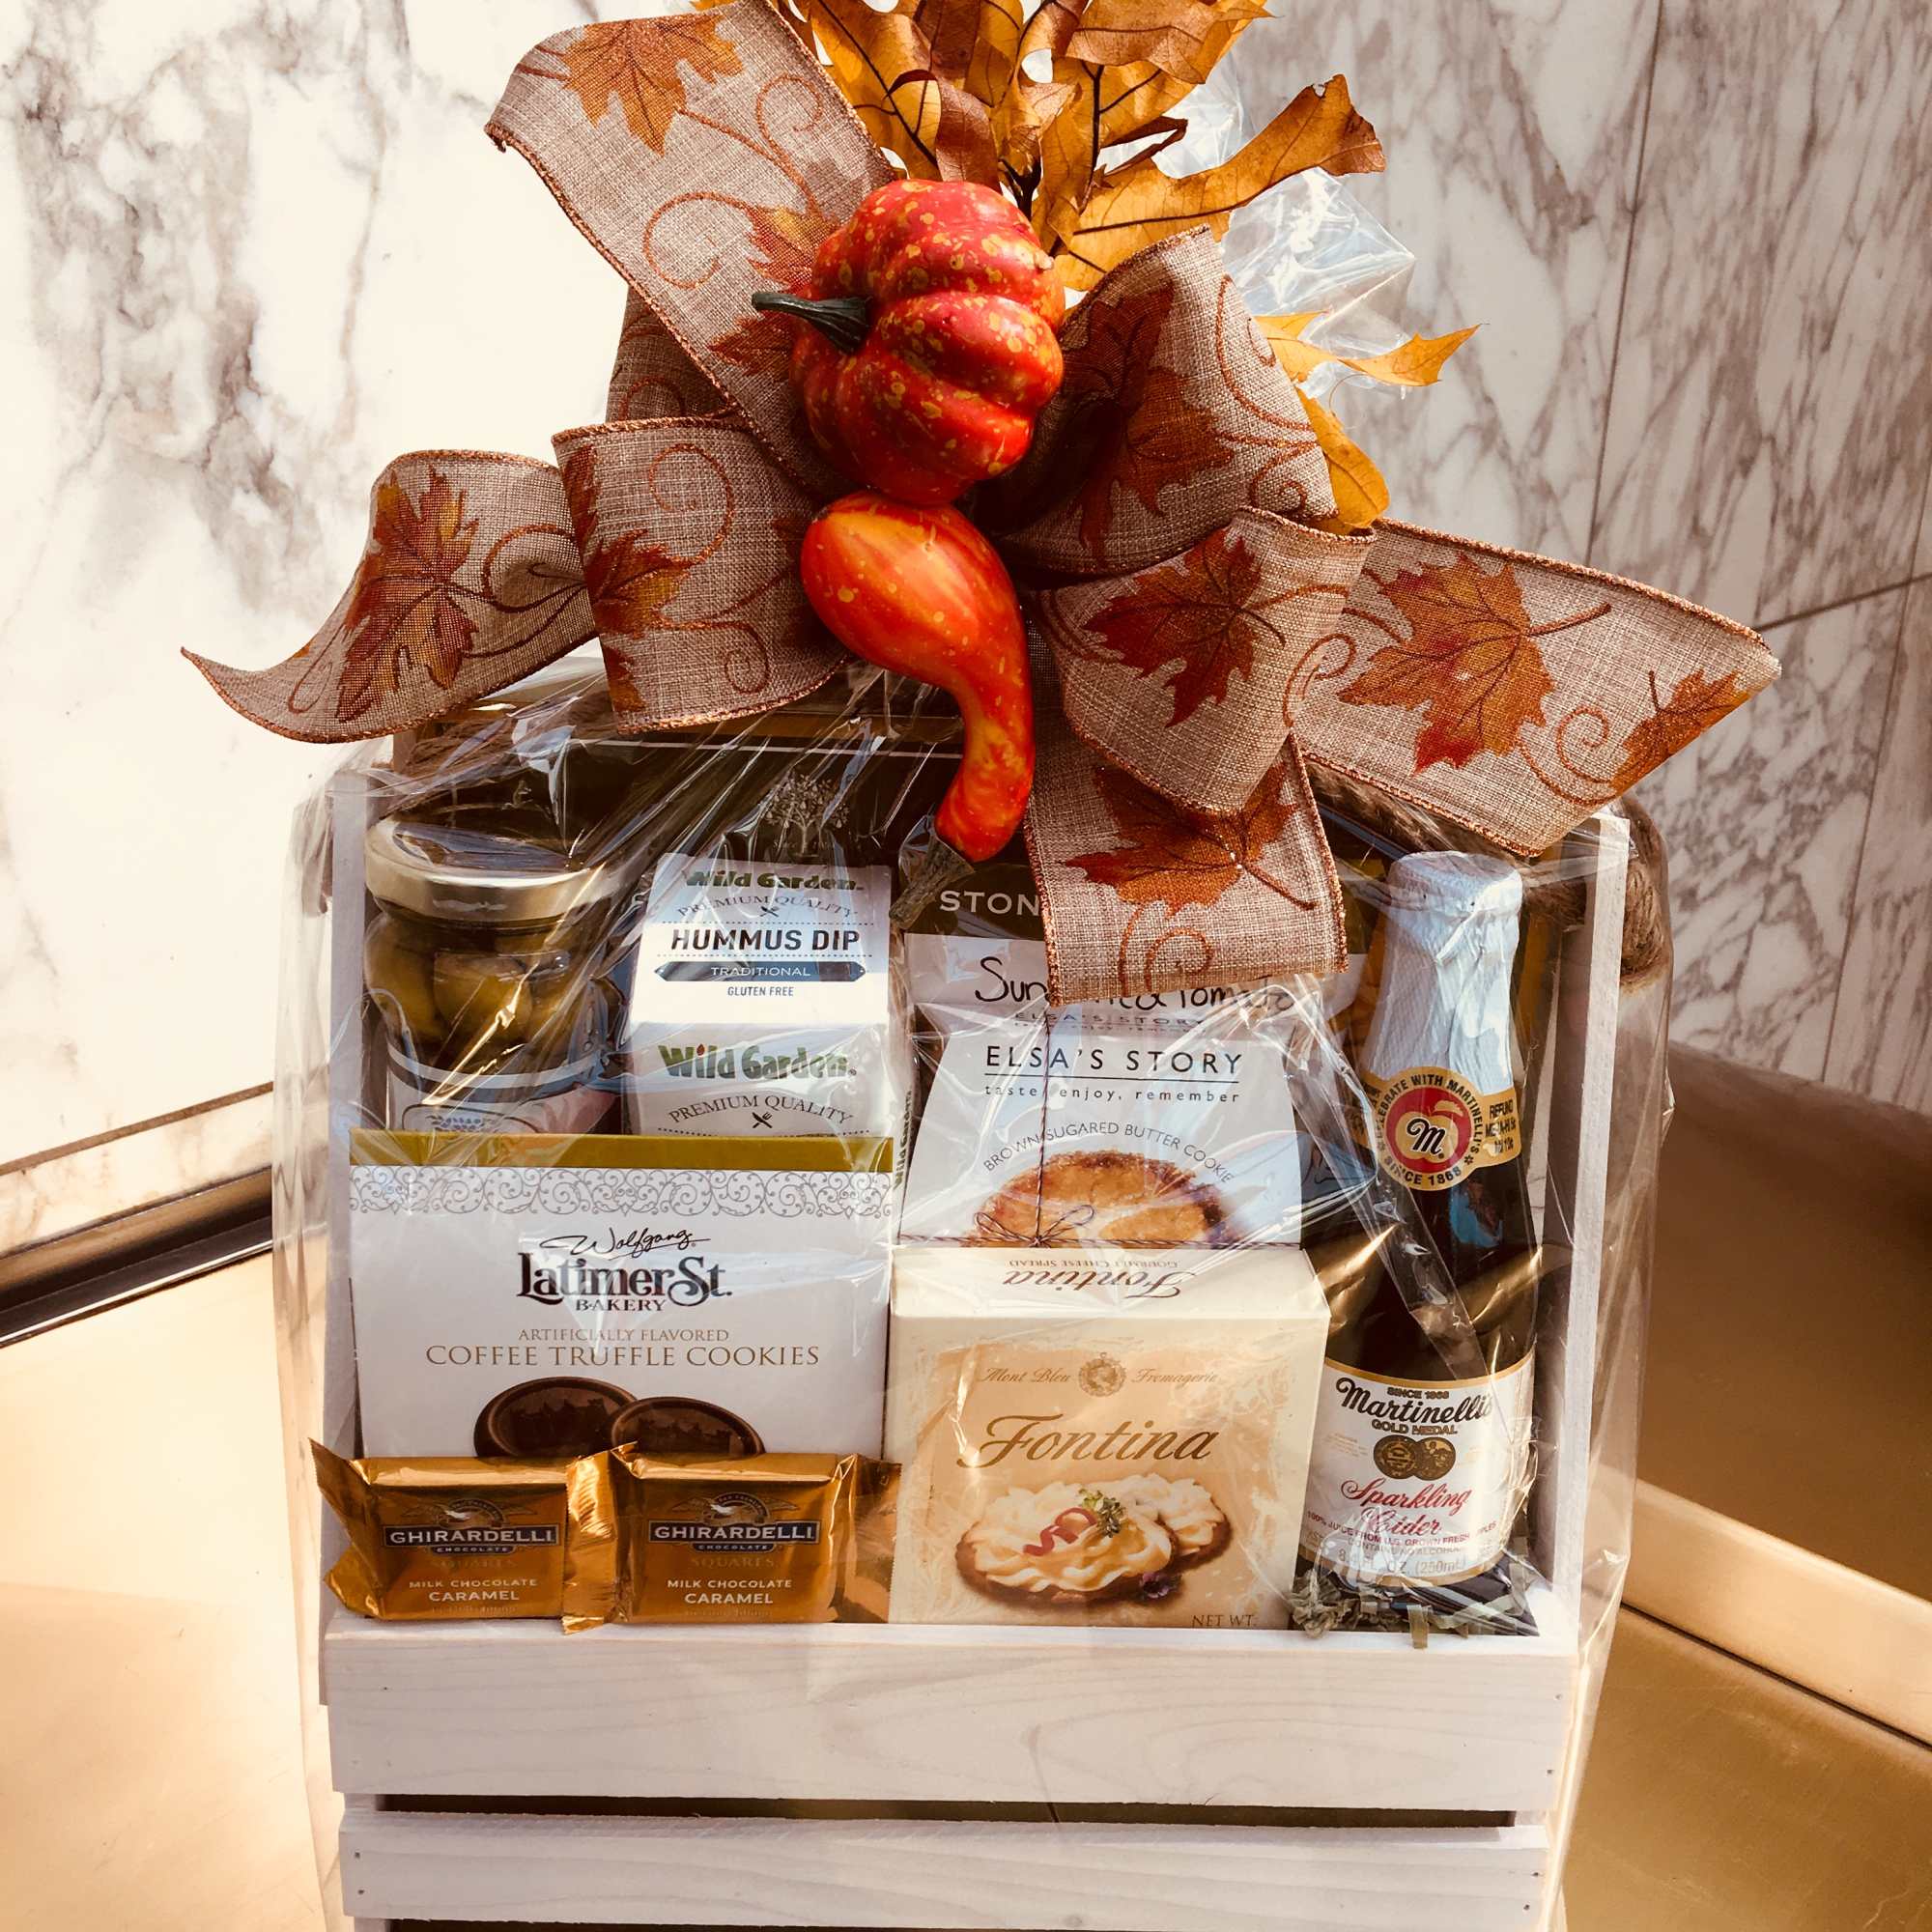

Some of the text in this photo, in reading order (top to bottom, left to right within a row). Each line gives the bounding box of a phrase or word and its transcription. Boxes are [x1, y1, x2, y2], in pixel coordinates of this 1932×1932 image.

[687, 870, 751, 888] Wild
[677, 895, 852, 918] PREMIUM QUALITY
[671, 929, 860, 952] HUMMUS DIP
[711, 967, 811, 977] TRADITIONAL
[975, 956, 1049, 1003] Sun
[727, 986, 794, 997] GLUTEN FREE
[657, 1043, 736, 1079] Wild
[987, 1046, 1242, 1074] ELSA'S STORY
[1060, 1088, 1122, 1104] enjoy,
[1136, 1090, 1240, 1103] remember
[668, 1094, 854, 1124] PREMIUM QUALITY
[1411, 1074, 1443, 1086] WITH
[1447, 1079, 1484, 1154] MARTINELLI'S
[983, 1122, 1233, 1184] BROWN SUGARED BUTTER COOKIE
[1384, 1156, 1423, 1185] SINCE
[1428, 1166, 1463, 1186] 1868
[539, 1227, 711, 1262] Wolfgang
[1008, 1259, 1056, 1267] SPREAD
[1003, 1270, 1197, 1299] Fontina
[576, 1299, 667, 1312] BAKERY
[518, 1328, 729, 1342] ARTIFICIALLY FLAVORED
[426, 1346, 820, 1367] COFFEE TRUFFLE COOKIES
[981, 1366, 1025, 1383] Mont
[1387, 1387, 1423, 1400] SINCE
[1372, 1419, 1458, 1435] GOLD MEDAL
[956, 1413, 1219, 1468] Fontina
[1341, 1478, 1473, 1516] Sparkling
[389, 1529, 553, 1545] GHIRARDELLI
[653, 1525, 814, 1540] GHIRARDELLI
[410, 1578, 538, 1588] MILK CHOCOLATE
[668, 1578, 792, 1589] MILK CHOCOLATE
[429, 1591, 520, 1603] CARAMEL
[685, 1593, 774, 1605] CARAMEL
[1191, 1614, 1224, 1628] NET
